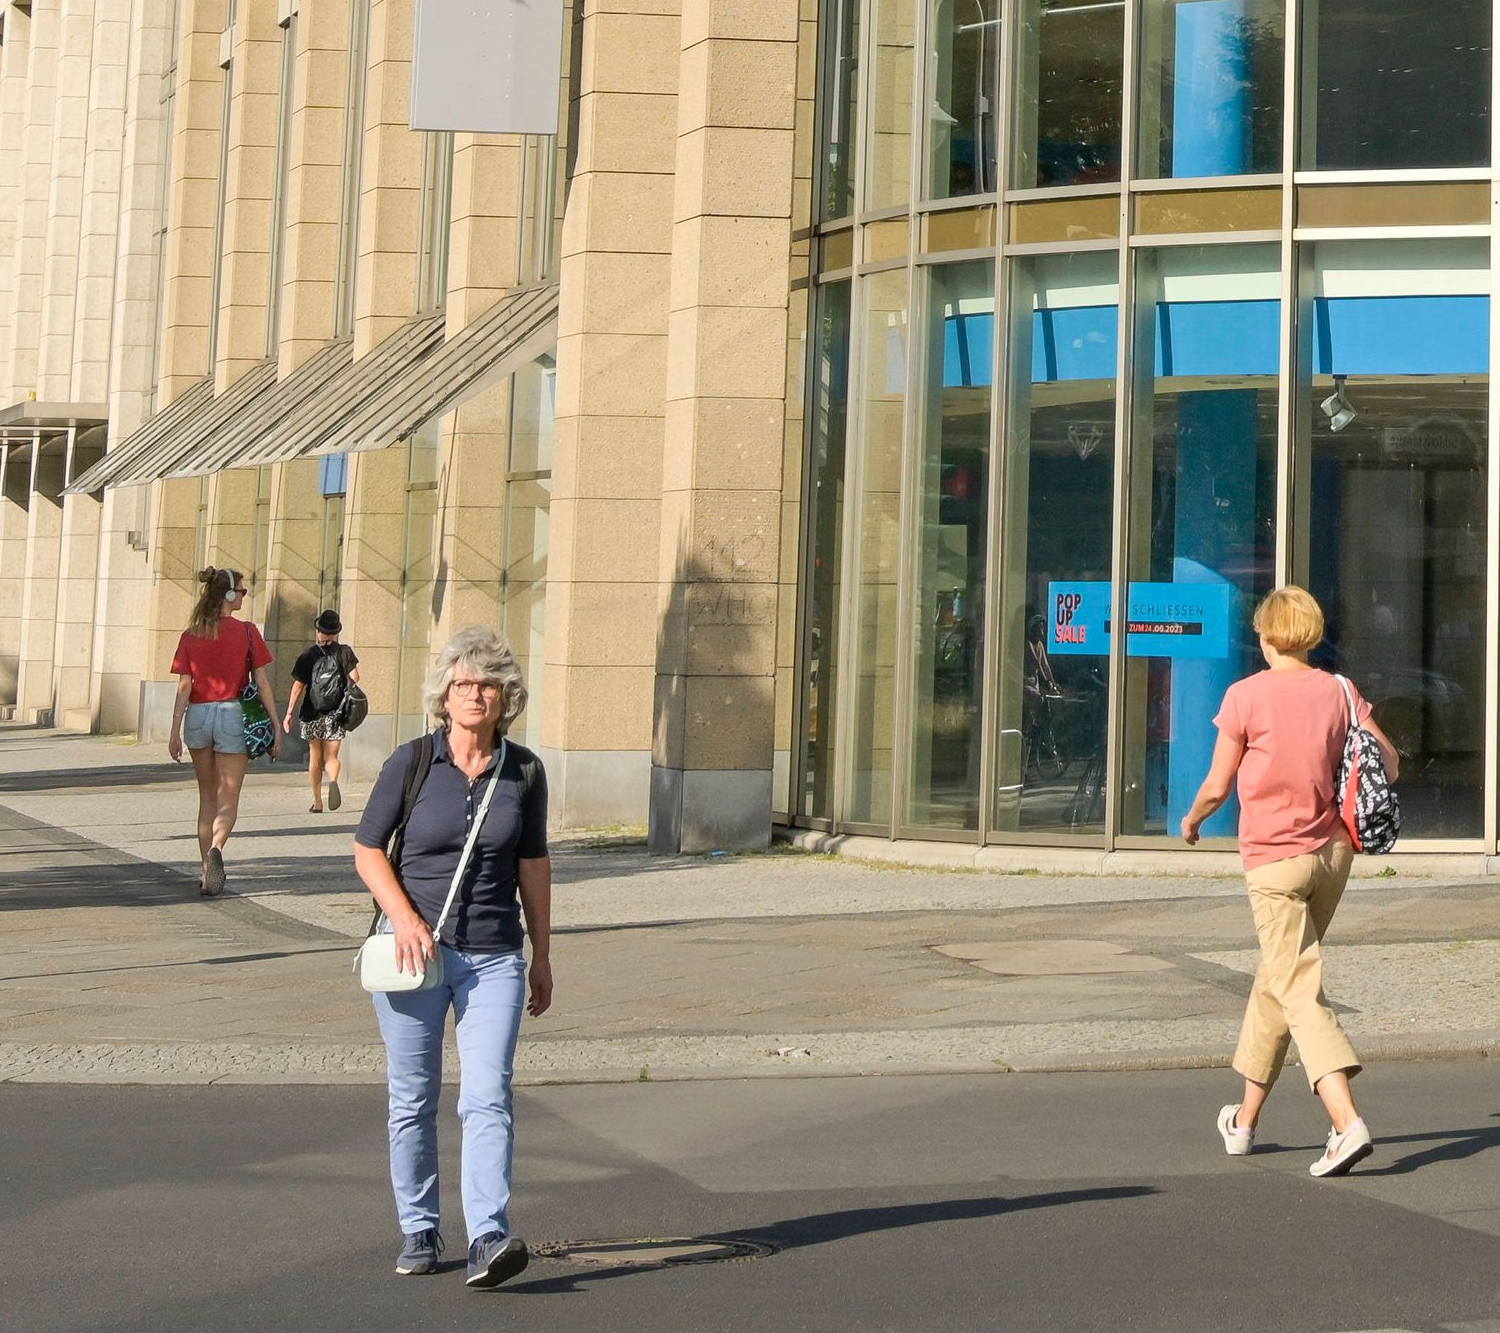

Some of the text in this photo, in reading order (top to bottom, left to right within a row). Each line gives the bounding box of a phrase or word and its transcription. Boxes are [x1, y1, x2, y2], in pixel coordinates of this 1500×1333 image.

[1056, 593, 1082, 610] POP
[1132, 603, 1204, 616] SCHLIESSEN
[1056, 610, 1073, 626] UP
[1055, 625, 1086, 643] SALE
